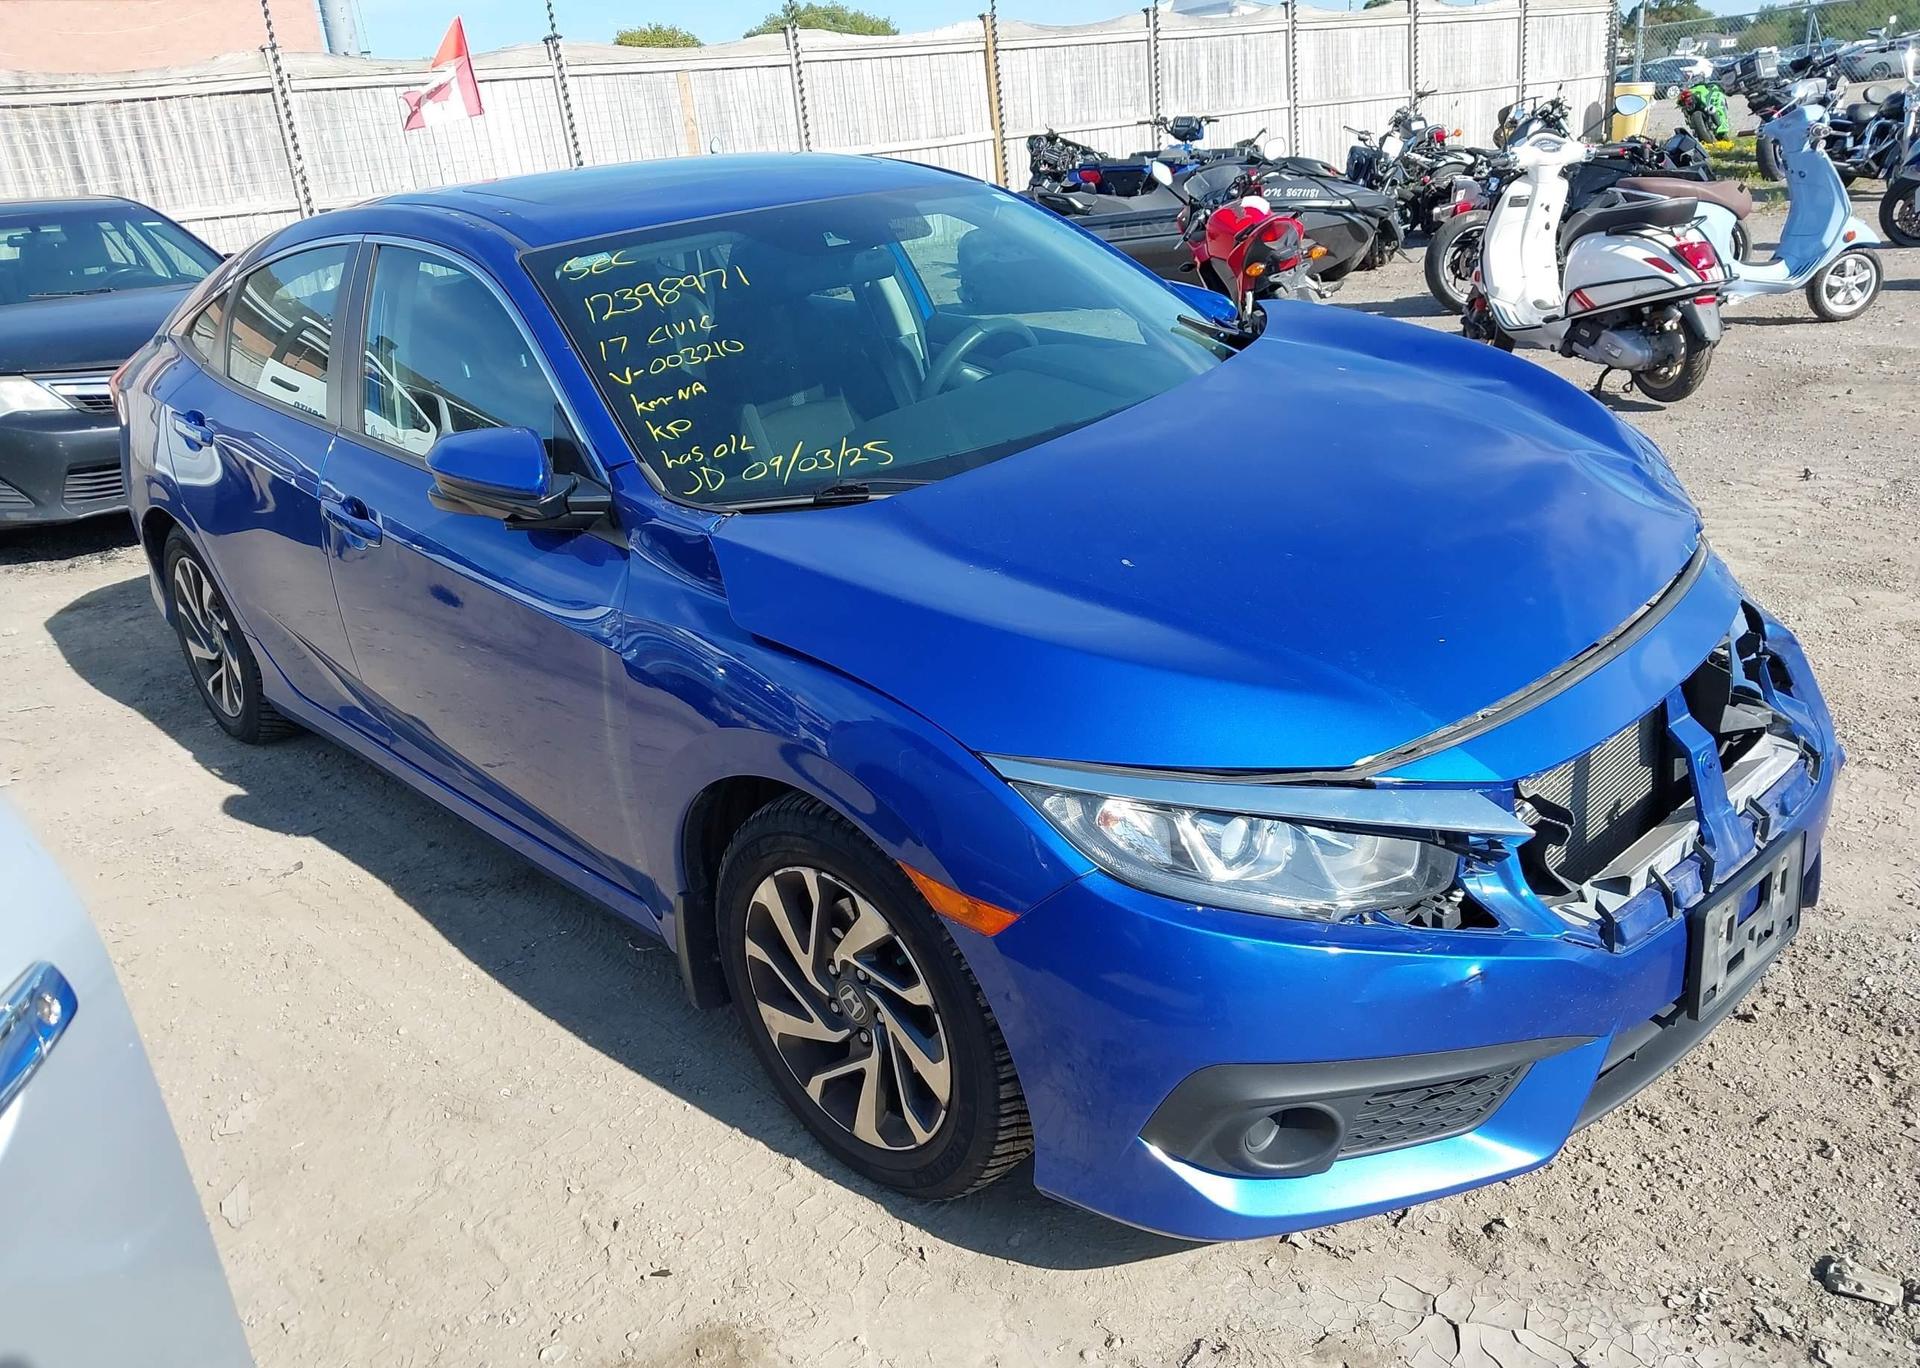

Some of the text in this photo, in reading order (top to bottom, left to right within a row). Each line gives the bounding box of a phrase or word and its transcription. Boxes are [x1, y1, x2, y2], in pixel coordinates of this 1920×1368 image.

[585, 265, 750, 323] 12398971
[600, 314, 718, 361] 17 CIVIC
[742, 436, 894, 486] 09/03/25
